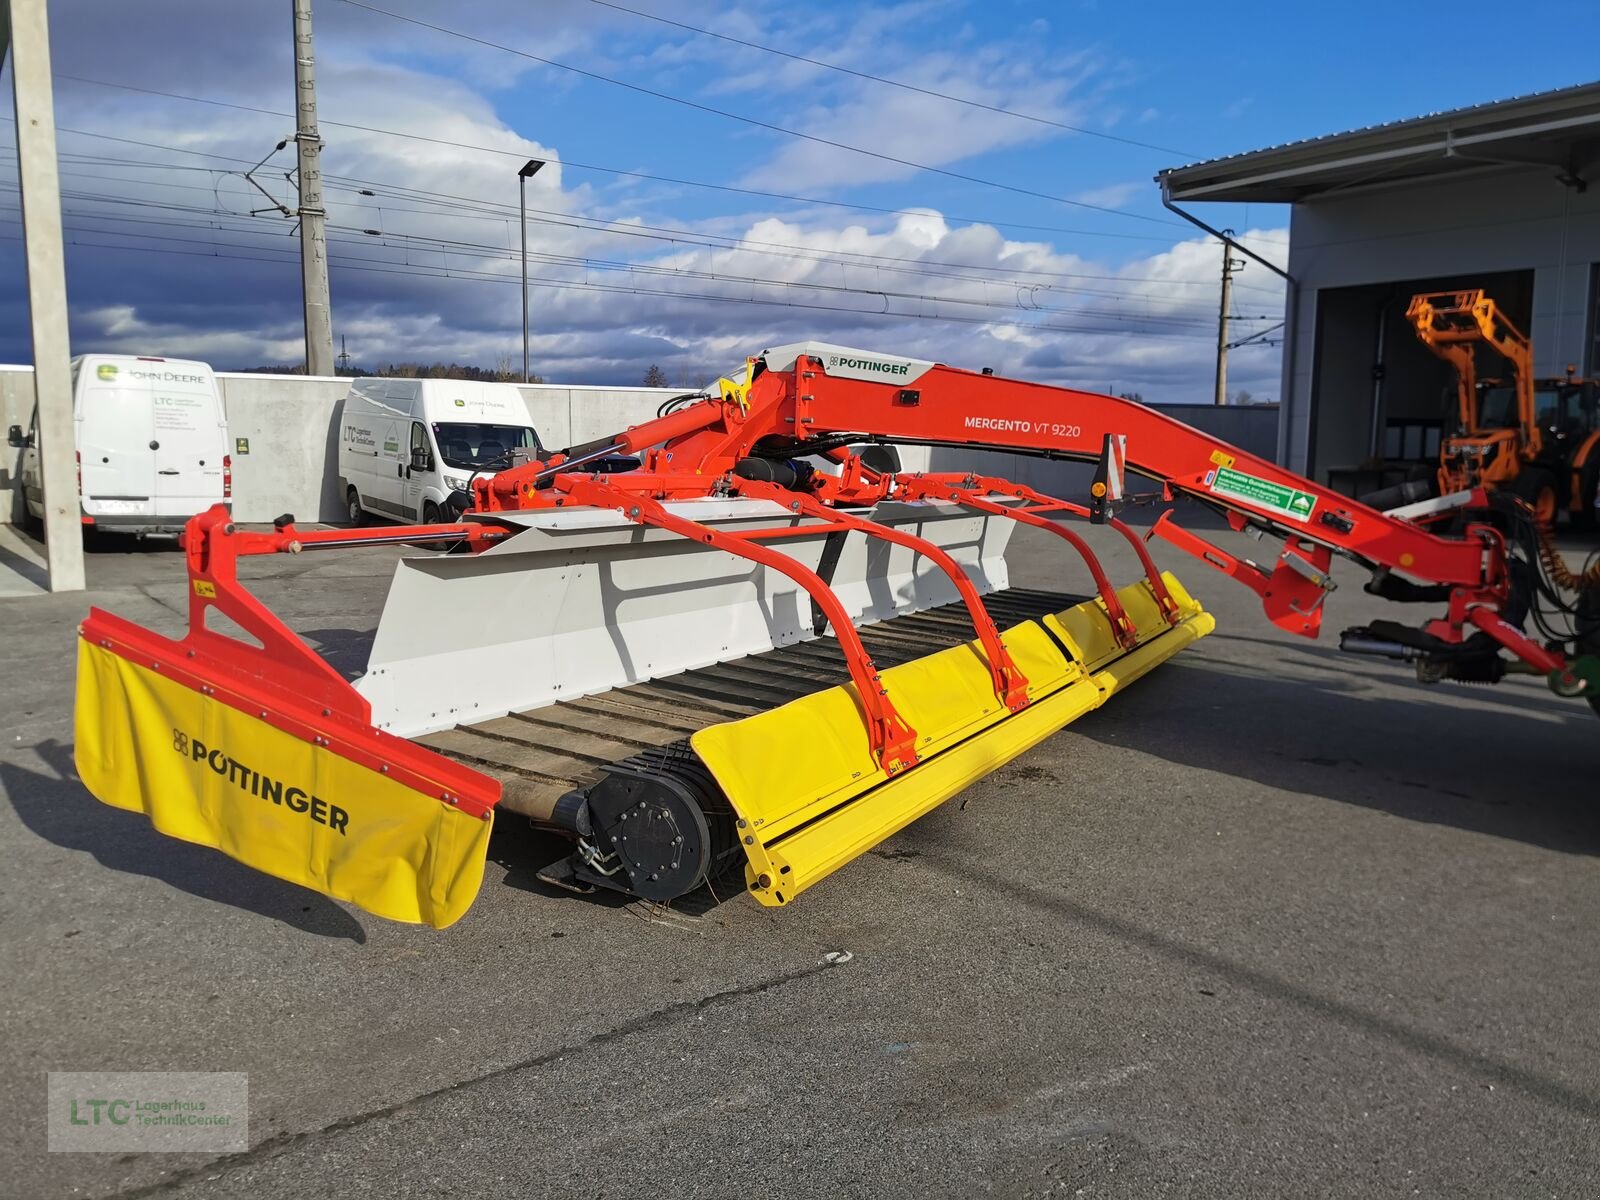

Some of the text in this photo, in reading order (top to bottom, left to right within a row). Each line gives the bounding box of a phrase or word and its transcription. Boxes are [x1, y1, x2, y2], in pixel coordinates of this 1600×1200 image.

[129, 368, 206, 384] JOHN DEERE
[154, 397, 173, 406] LTC
[344, 425, 357, 443] LTC
[964, 416, 1081, 437] MERGENTO VT 9220
